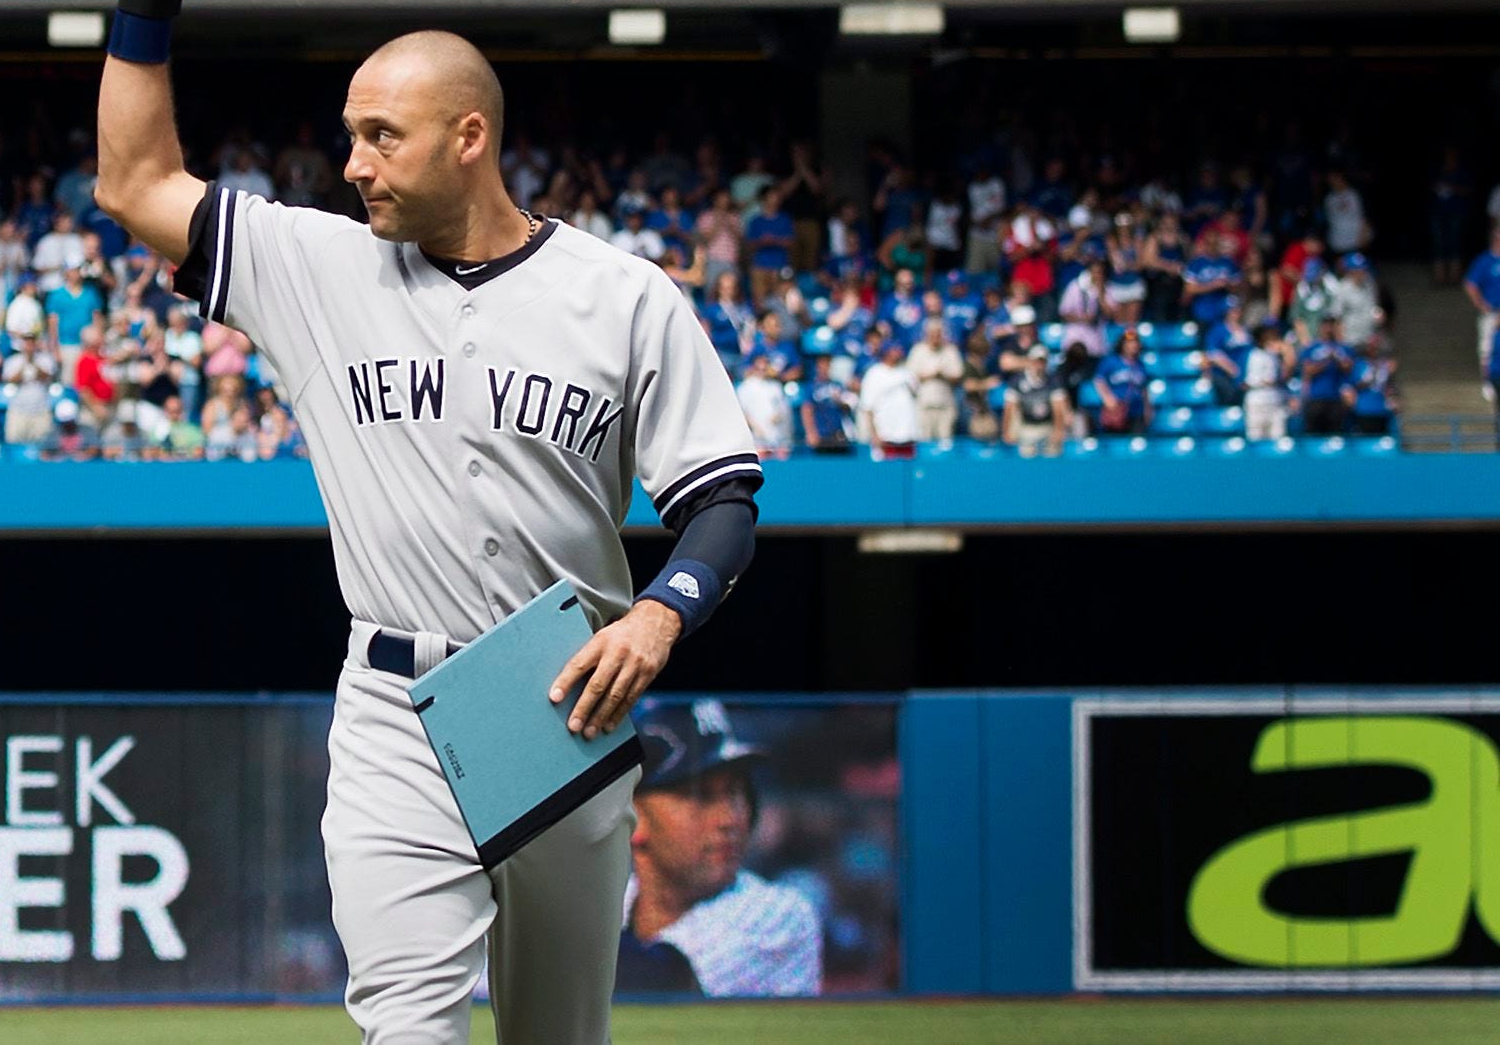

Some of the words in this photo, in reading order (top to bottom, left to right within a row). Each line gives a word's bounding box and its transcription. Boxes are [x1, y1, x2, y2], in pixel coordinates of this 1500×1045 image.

[347, 356, 445, 427] NEW
[486, 365, 625, 464] YORK
[1186, 714, 1500, 967] a
